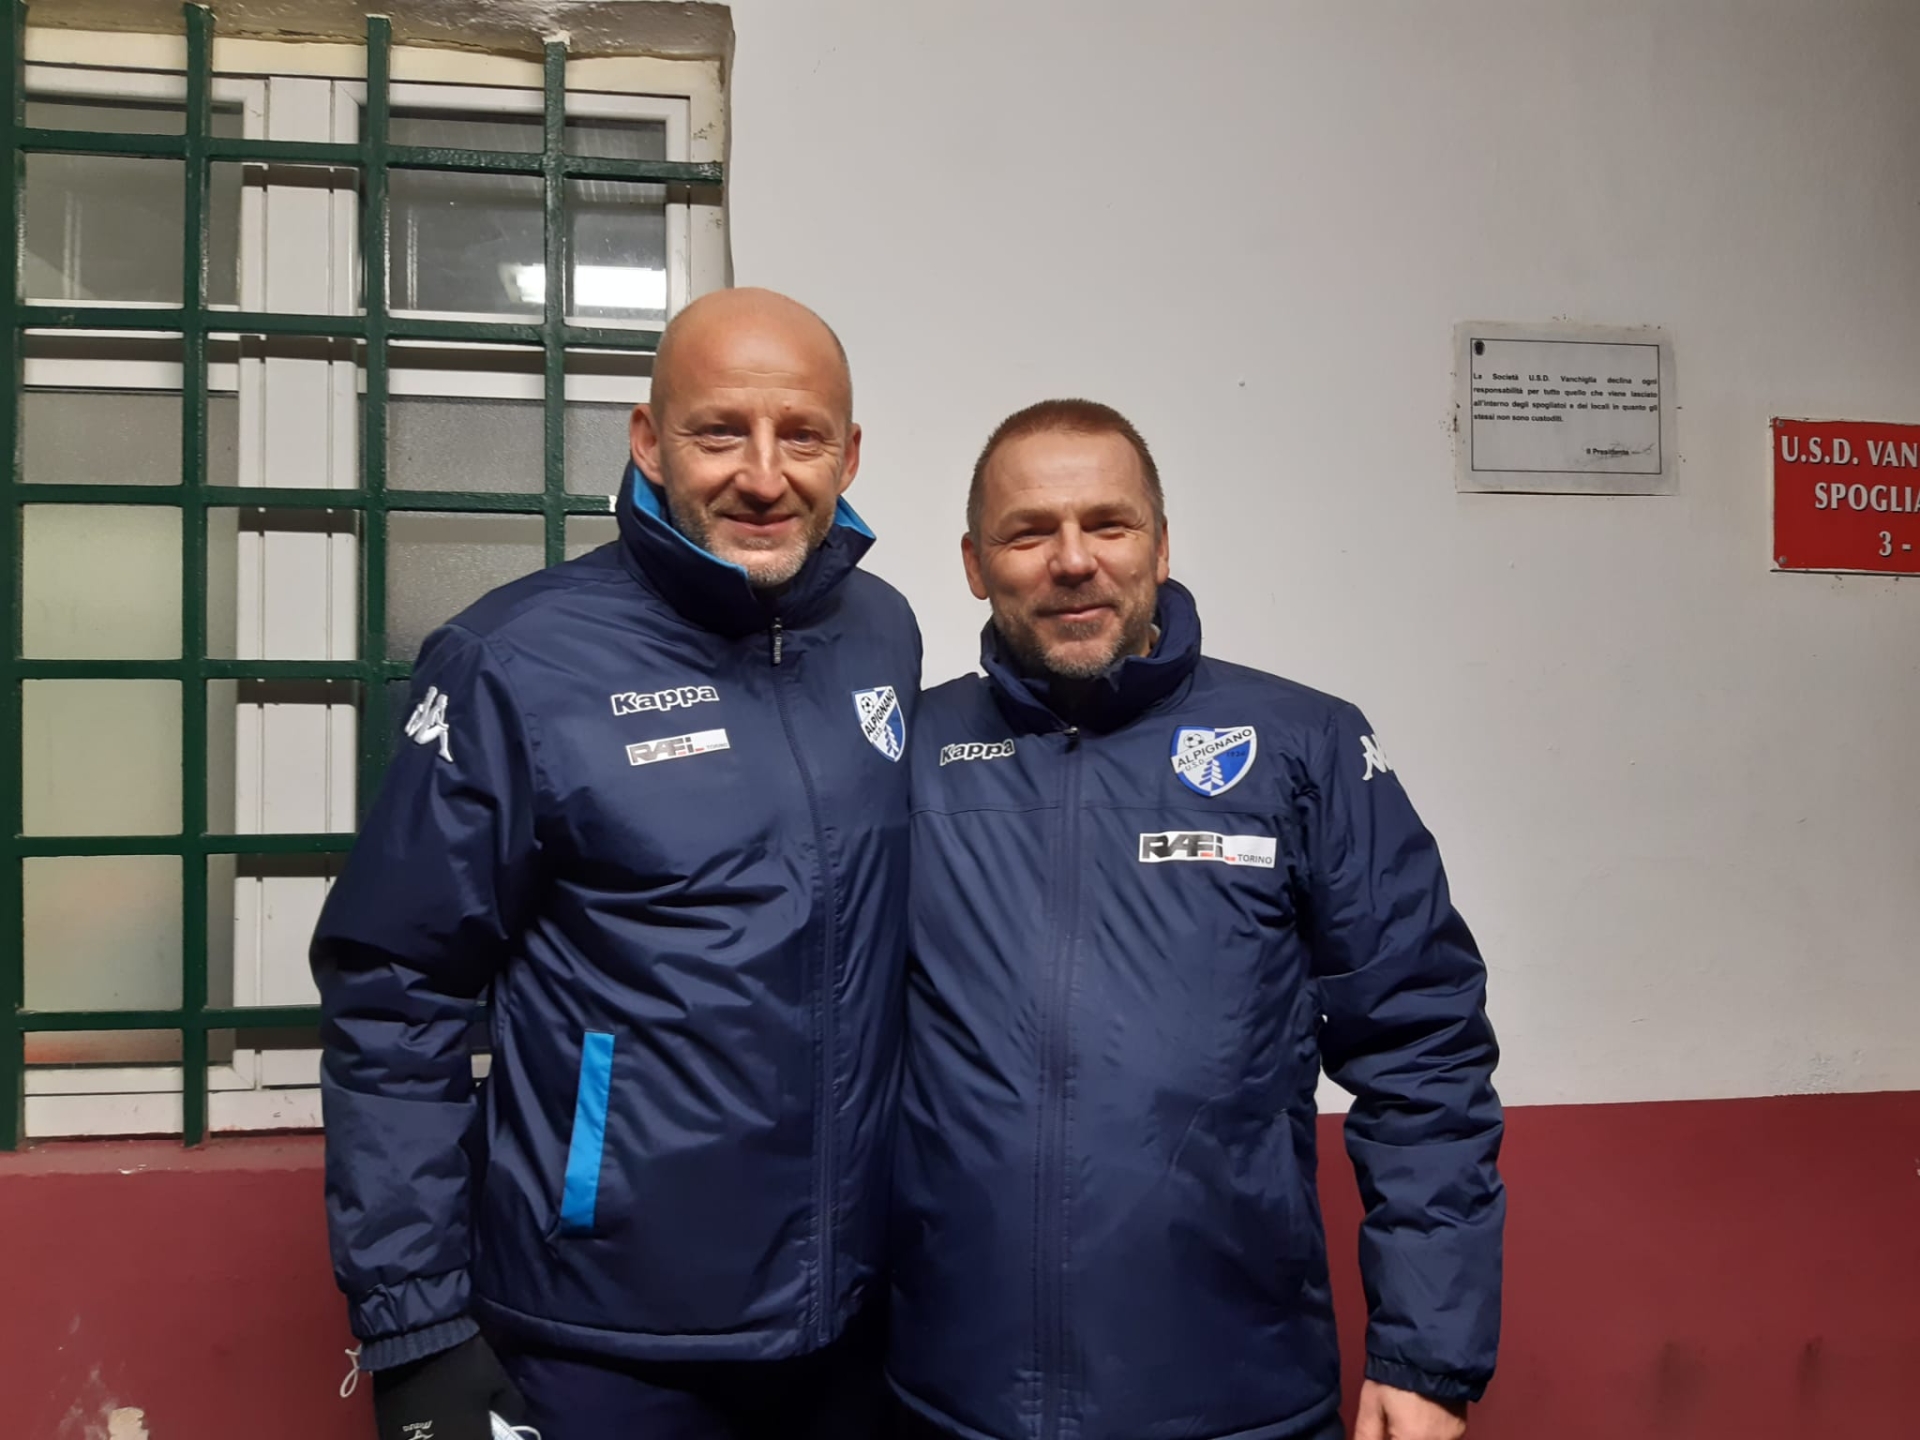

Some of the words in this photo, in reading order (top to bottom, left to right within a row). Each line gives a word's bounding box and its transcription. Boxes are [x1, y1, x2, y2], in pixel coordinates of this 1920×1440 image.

[1561, 376, 1596, 384] Vanchiglia
[1642, 378, 1657, 386] ogni
[1512, 400, 1529, 409] degli
[1649, 404, 1657, 412] gli
[1781, 435, 1859, 465] U.S.D.
[1878, 530, 1892, 556] 3
[611, 685, 720, 716] Kappa
[864, 688, 895, 737] ALPIGNANO
[939, 738, 1015, 766] Kappa
[1177, 729, 1252, 768] ALPIGNANO
[1237, 854, 1272, 864] TORINO
